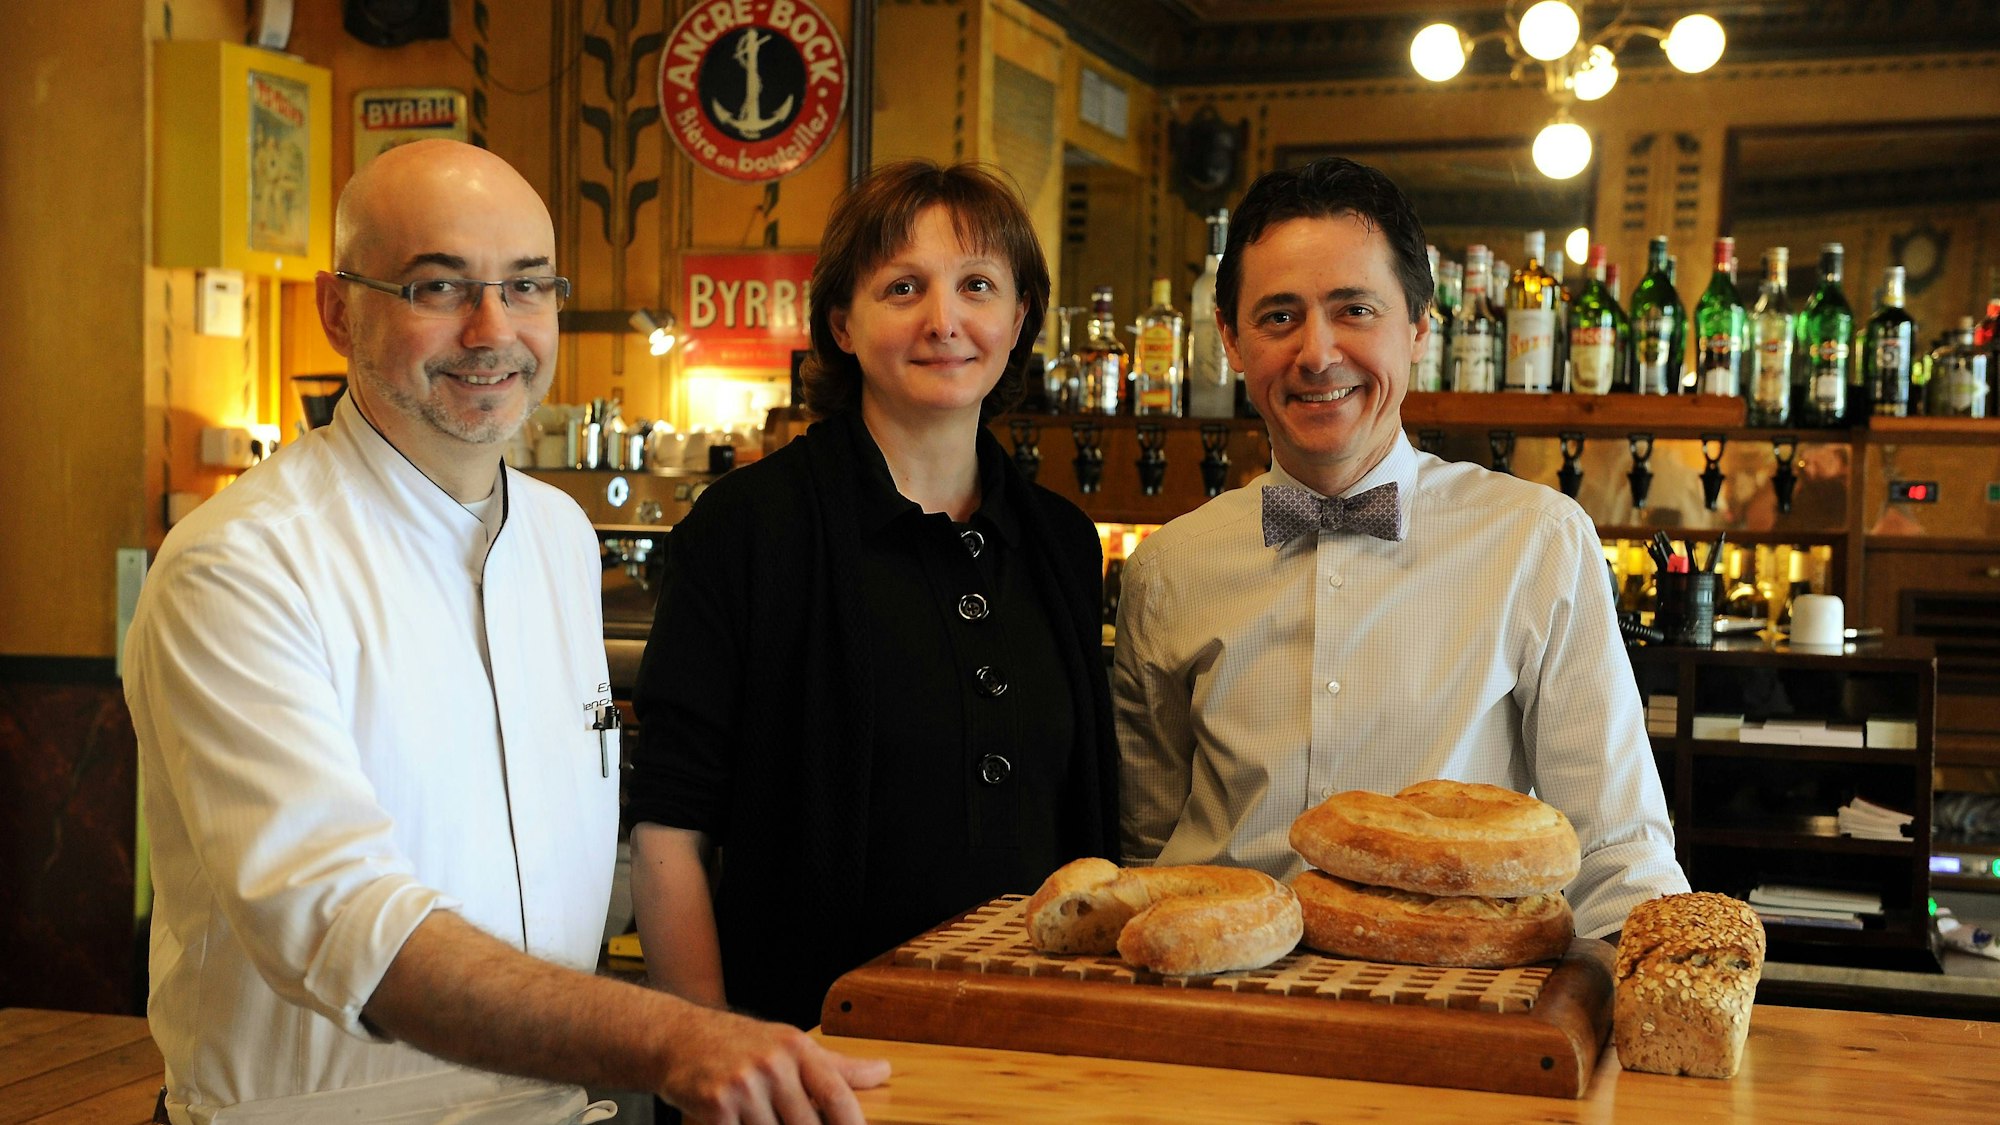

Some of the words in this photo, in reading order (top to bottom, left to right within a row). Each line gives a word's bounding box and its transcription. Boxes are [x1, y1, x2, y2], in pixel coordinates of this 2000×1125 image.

[367, 98, 451, 127] BYRRH
[715, 154, 736, 170] en
[738, 103, 829, 173] bouteilles
